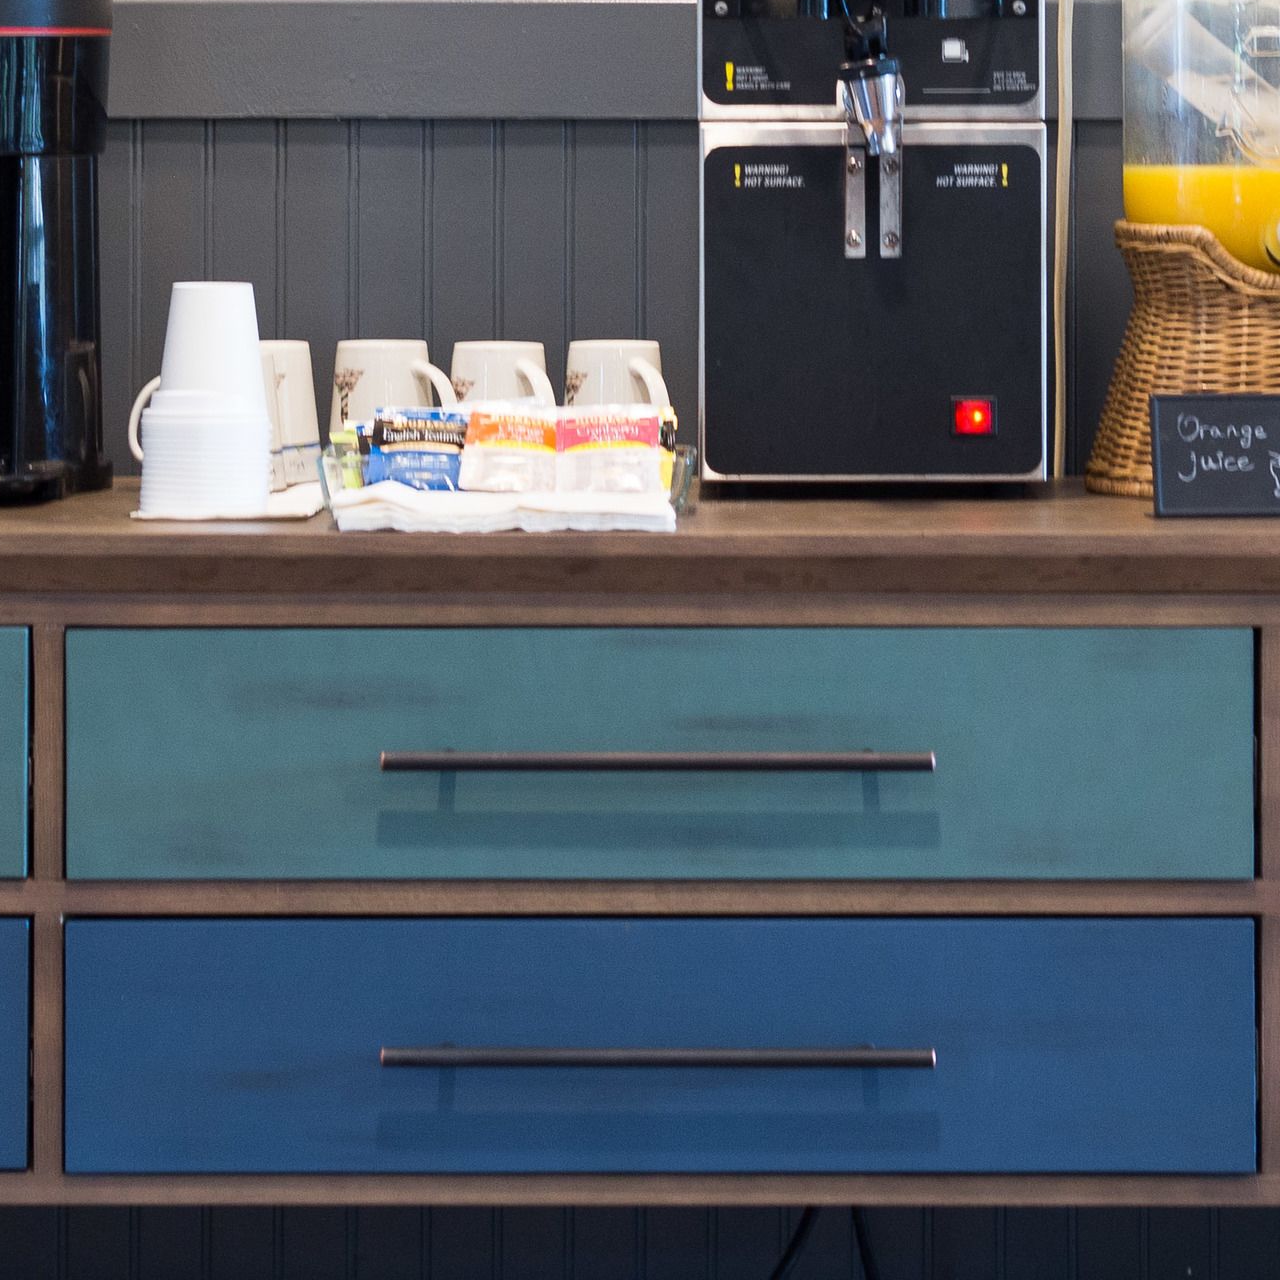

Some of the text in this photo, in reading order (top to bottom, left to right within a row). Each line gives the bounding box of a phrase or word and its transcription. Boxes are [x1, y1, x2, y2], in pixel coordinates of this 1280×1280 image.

[744, 164, 789, 176] WARNING!
[953, 163, 999, 176] WARNING!
[744, 176, 762, 188] HOT
[936, 176, 954, 188] HOT
[382, 427, 421, 443] English
[1177, 412, 1268, 450] Orange
